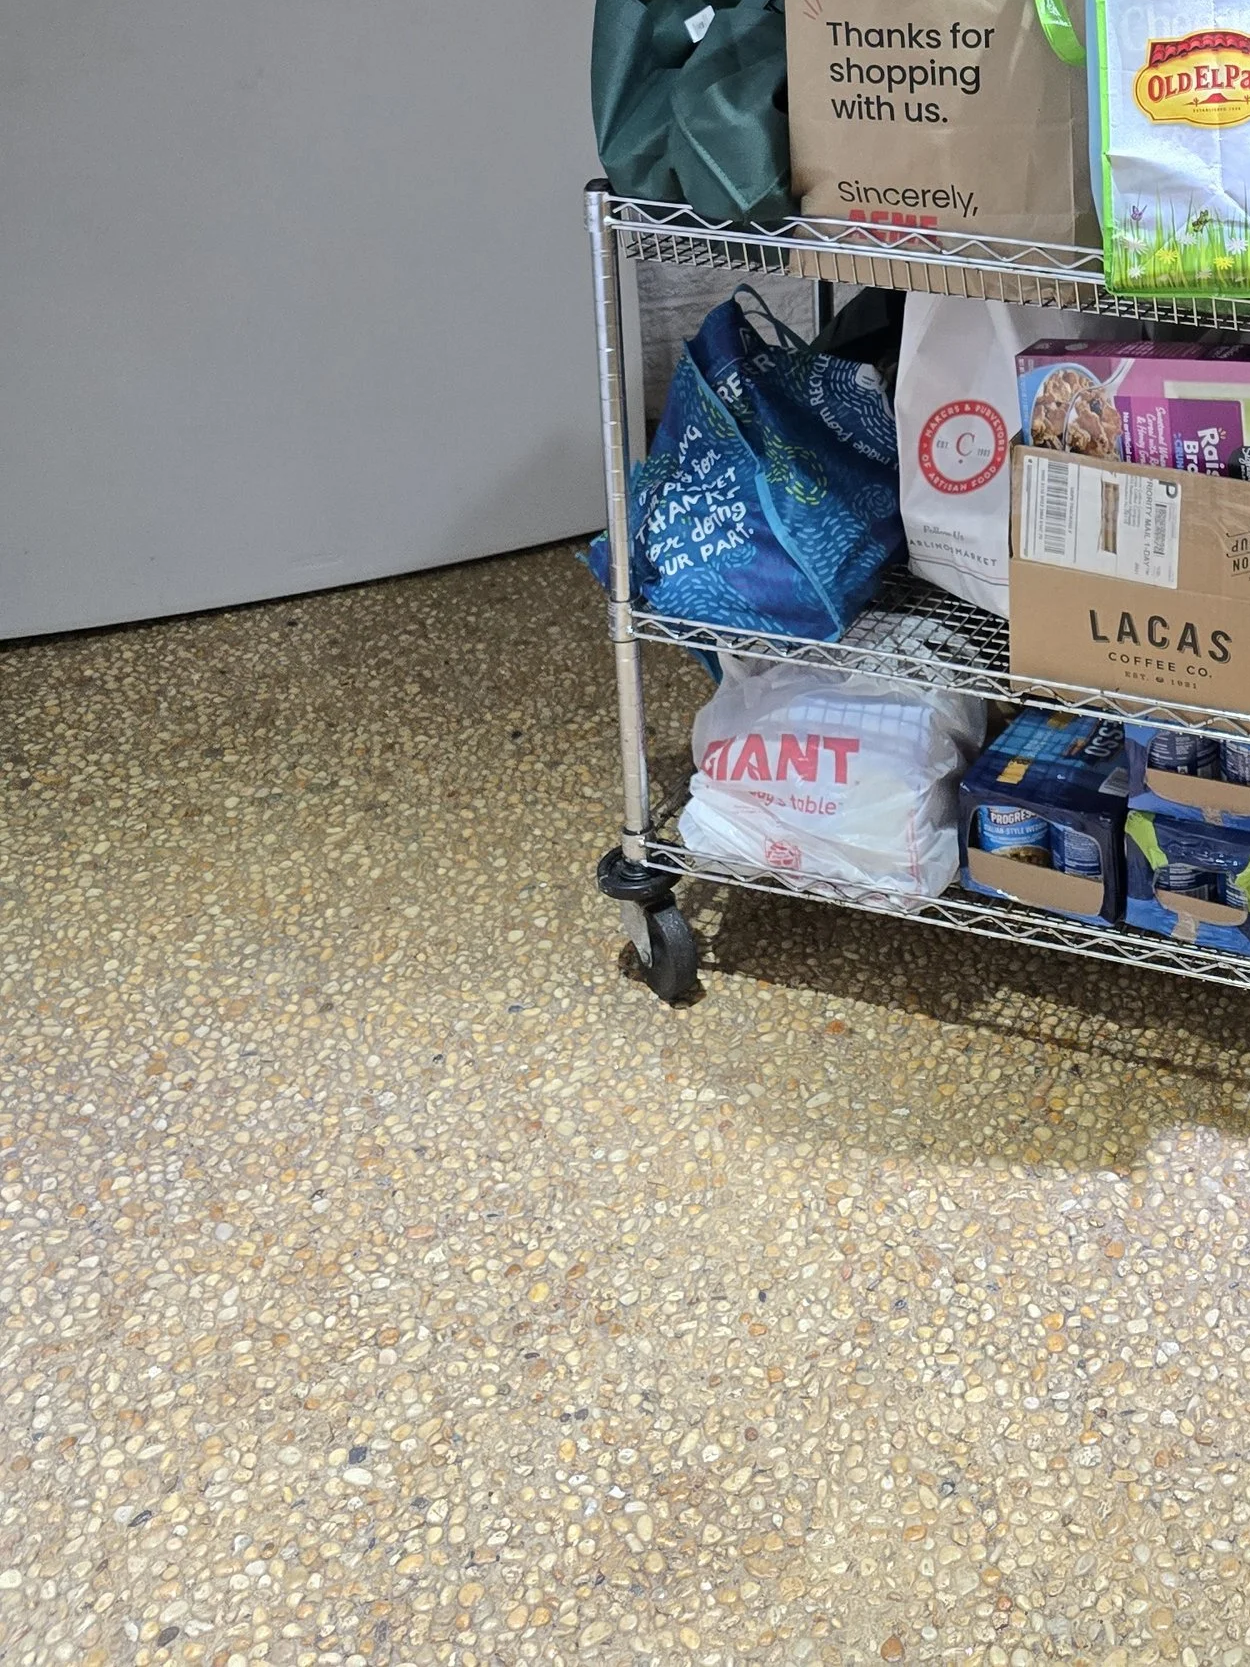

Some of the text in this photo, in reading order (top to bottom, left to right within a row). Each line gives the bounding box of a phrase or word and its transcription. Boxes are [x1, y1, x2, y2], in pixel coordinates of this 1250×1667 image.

[826, 21, 995, 49] Thanks for
[830, 57, 980, 95] shopping
[831, 93, 948, 123] with us.
[838, 180, 979, 218] Sincerely,
[820, 406, 854, 442] from
[925, 405, 960, 438] MAKERS
[975, 405, 1005, 452] PURVEYORS
[1122, 412, 1131, 422] No
[1123, 423, 1133, 454] artificial
[1134, 426, 1148, 449] Honey
[853, 440, 892, 465] made
[921, 454, 932, 468] OF
[928, 473, 968, 492] ARTISAN
[971, 465, 997, 488] FOOD
[1158, 480, 1178, 499] P
[635, 485, 741, 545] THANKS
[691, 501, 747, 543] doing
[1144, 518, 1152, 541] MAIL
[700, 522, 754, 564] PART.
[1089, 609, 1232, 664] LACAS
[1108, 651, 1213, 678] COFFEE CO.
